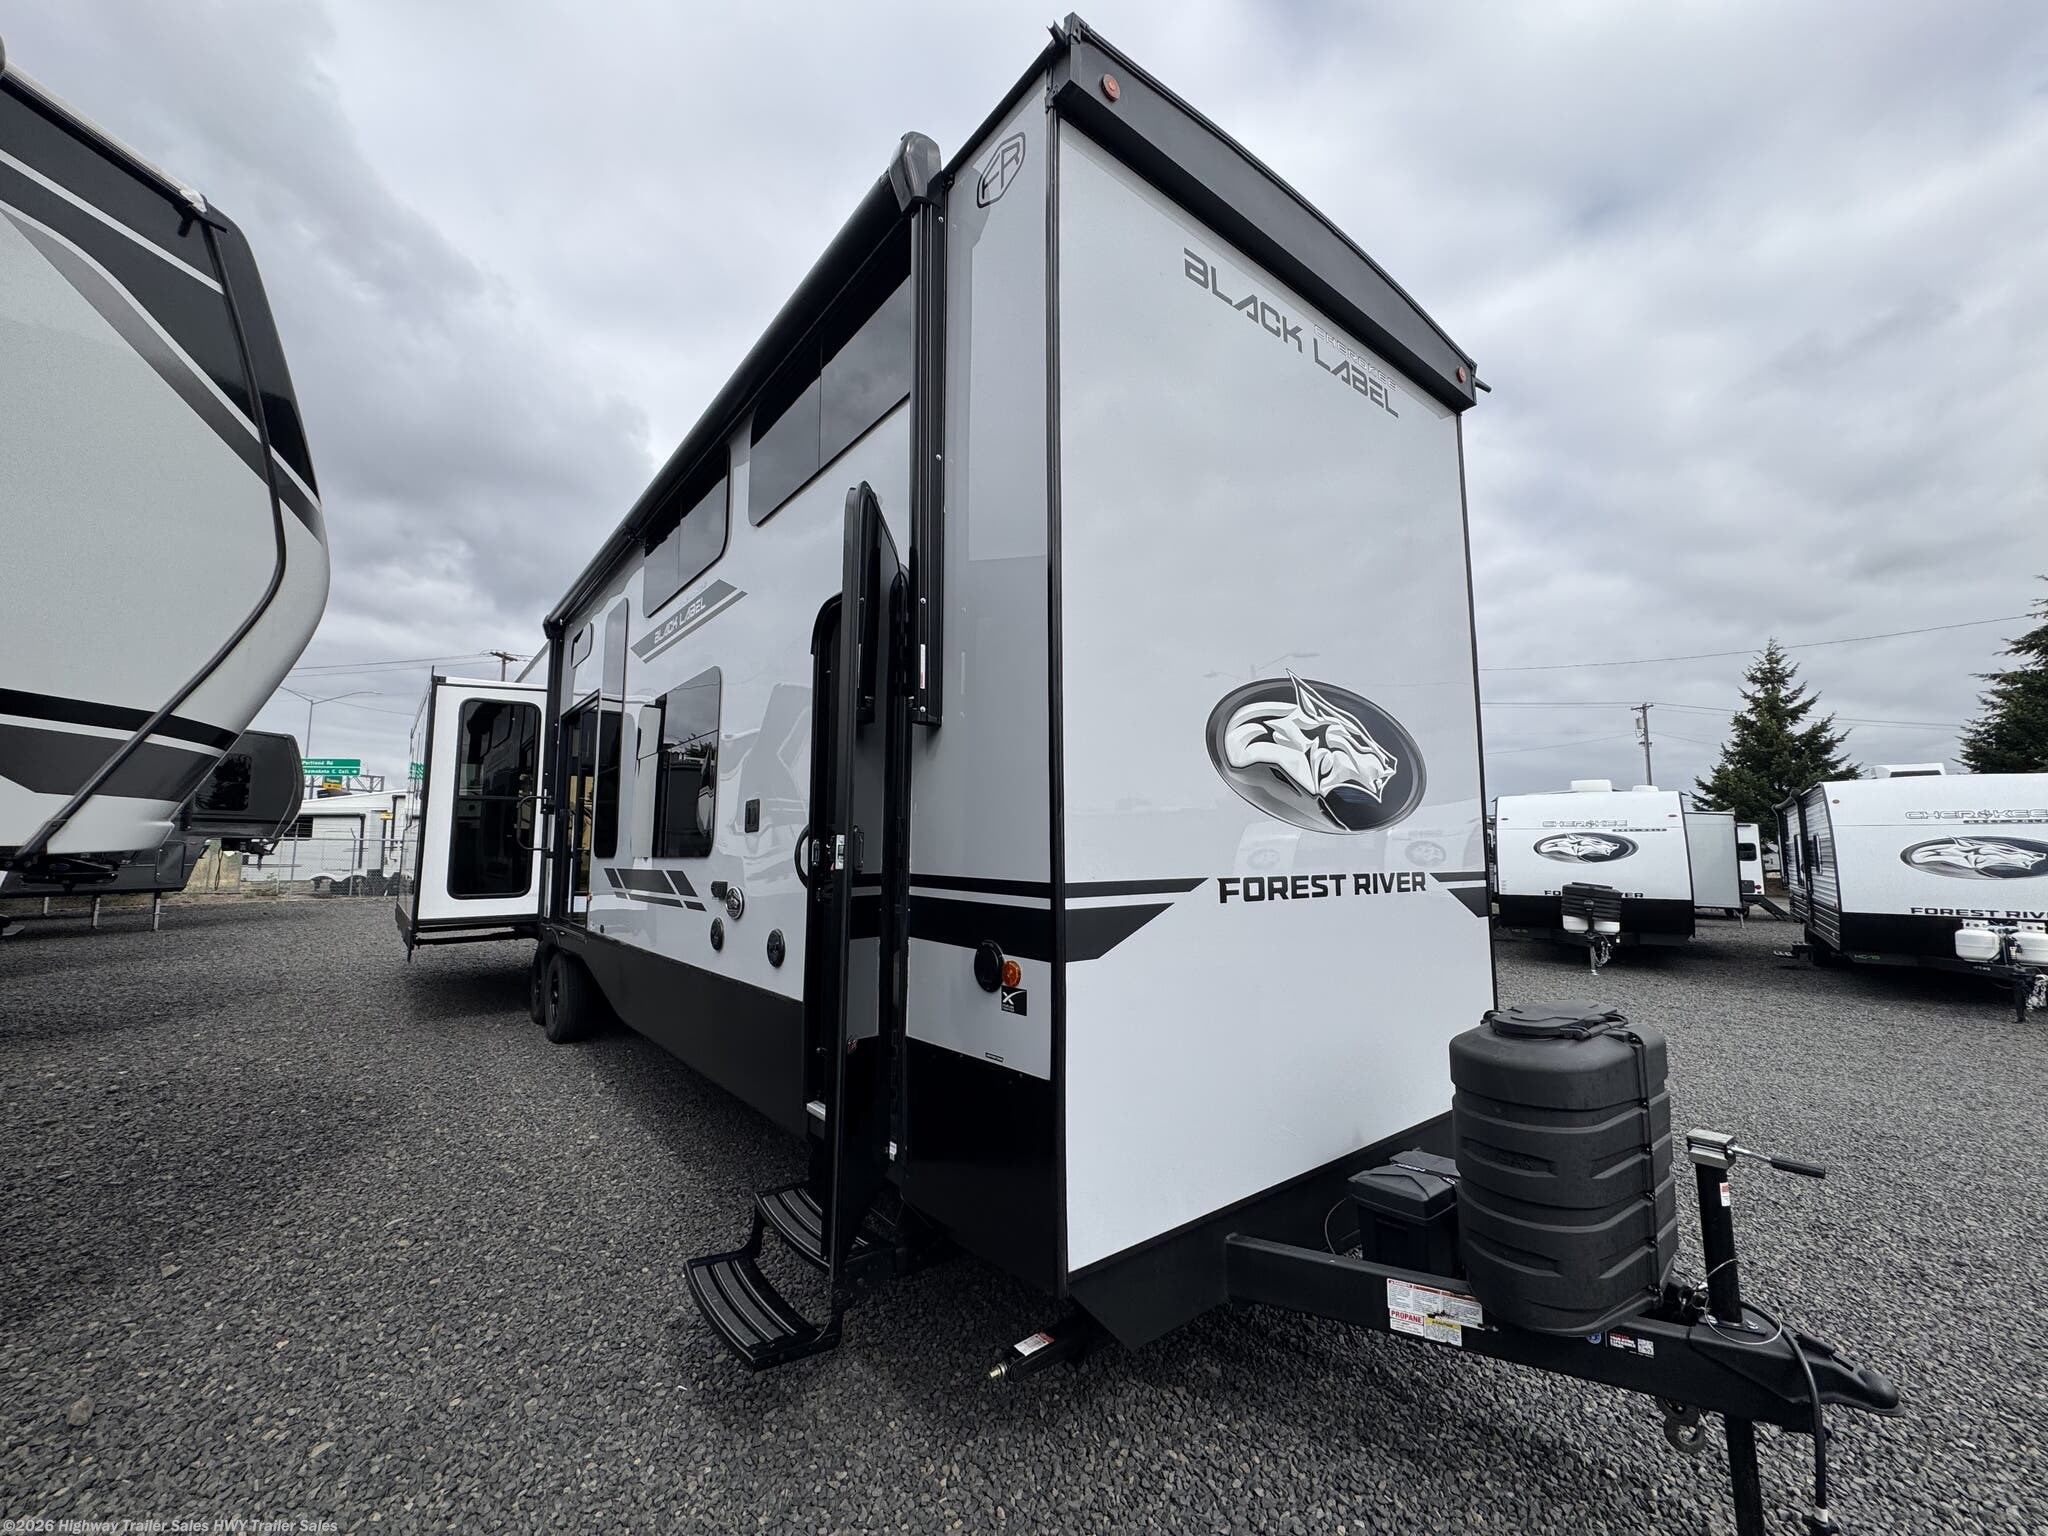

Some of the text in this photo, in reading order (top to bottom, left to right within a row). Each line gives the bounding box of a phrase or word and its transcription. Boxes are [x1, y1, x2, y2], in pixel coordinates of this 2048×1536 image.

[981, 141, 1020, 200] FR
[1183, 247, 1399, 419] BLACK LABEL
[1313, 323, 1399, 392] CHEROKEE
[654, 597, 706, 644] BLACK LABEL
[1542, 819, 1628, 828] CHEROKEE
[1905, 808, 2048, 819] CHEROKEE
[1217, 871, 1427, 904] FOREST RIVER
[1910, 907, 2048, 919] FOREST RIV
[1391, 1310, 1422, 1324] PROPANE
